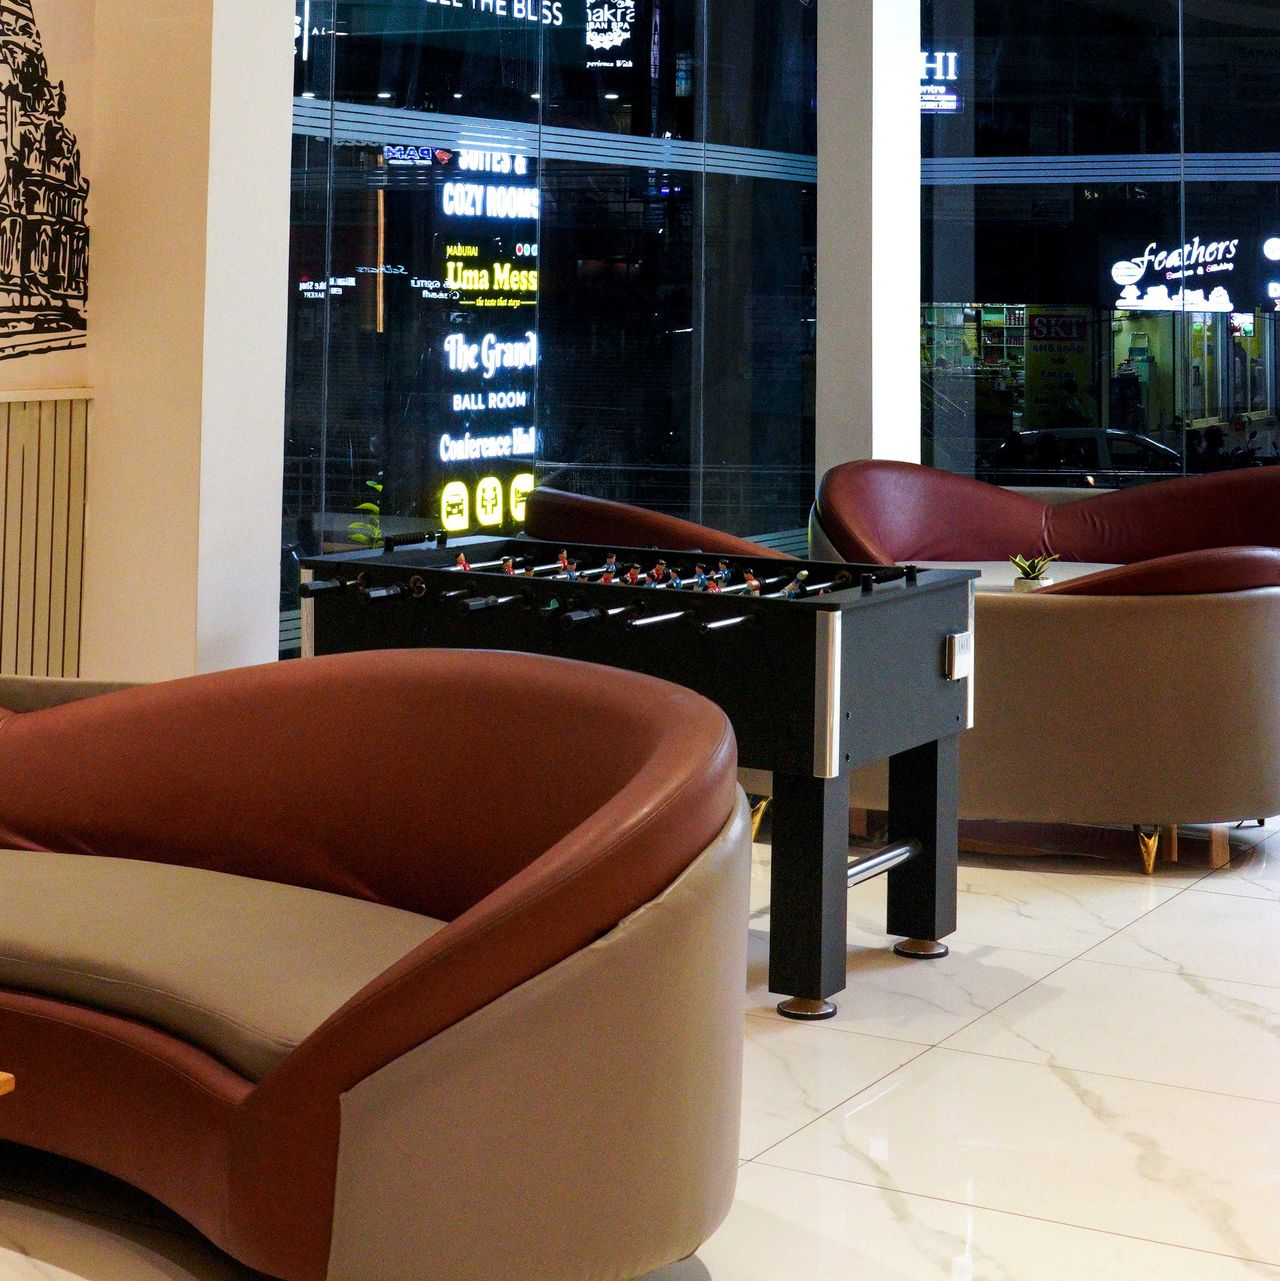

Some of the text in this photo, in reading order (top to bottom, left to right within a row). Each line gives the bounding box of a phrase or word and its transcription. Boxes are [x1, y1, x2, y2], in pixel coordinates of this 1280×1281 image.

[611, 21, 630, 30] SPA
[443, 182, 539, 219] COZY ROOMS
[446, 245, 479, 257] MADURAI
[1131, 235, 1239, 271] feathers
[446, 261, 490, 290] Uma
[492, 262, 538, 291] Mess
[443, 331, 537, 379] The Grand
[453, 391, 527, 411] BALL ROOM
[439, 432, 512, 461] Conference
